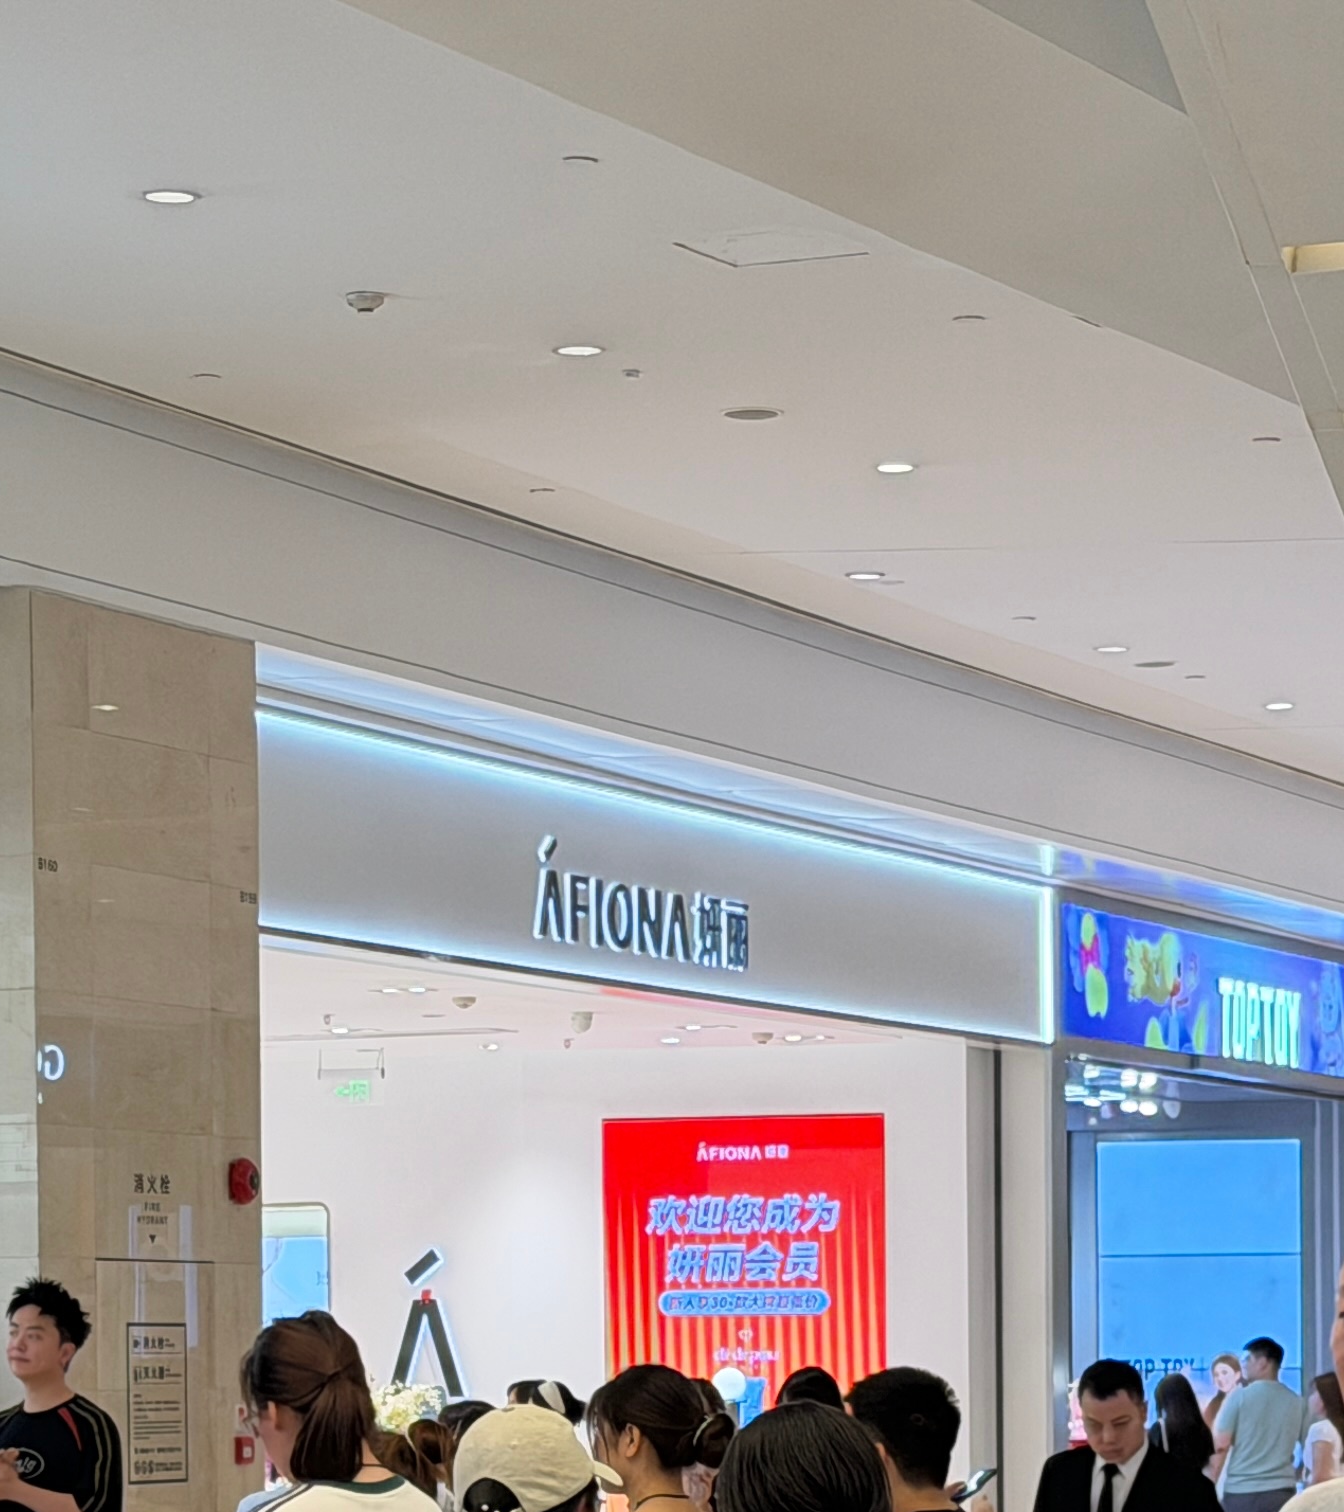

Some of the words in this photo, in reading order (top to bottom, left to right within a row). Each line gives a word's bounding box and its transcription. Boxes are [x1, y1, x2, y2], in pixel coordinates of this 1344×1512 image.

[133, 1173, 171, 1195] 消火栓
[645, 1193, 841, 1236] 欢迎您成为
[664, 1241, 819, 1283] 妍丽会员
